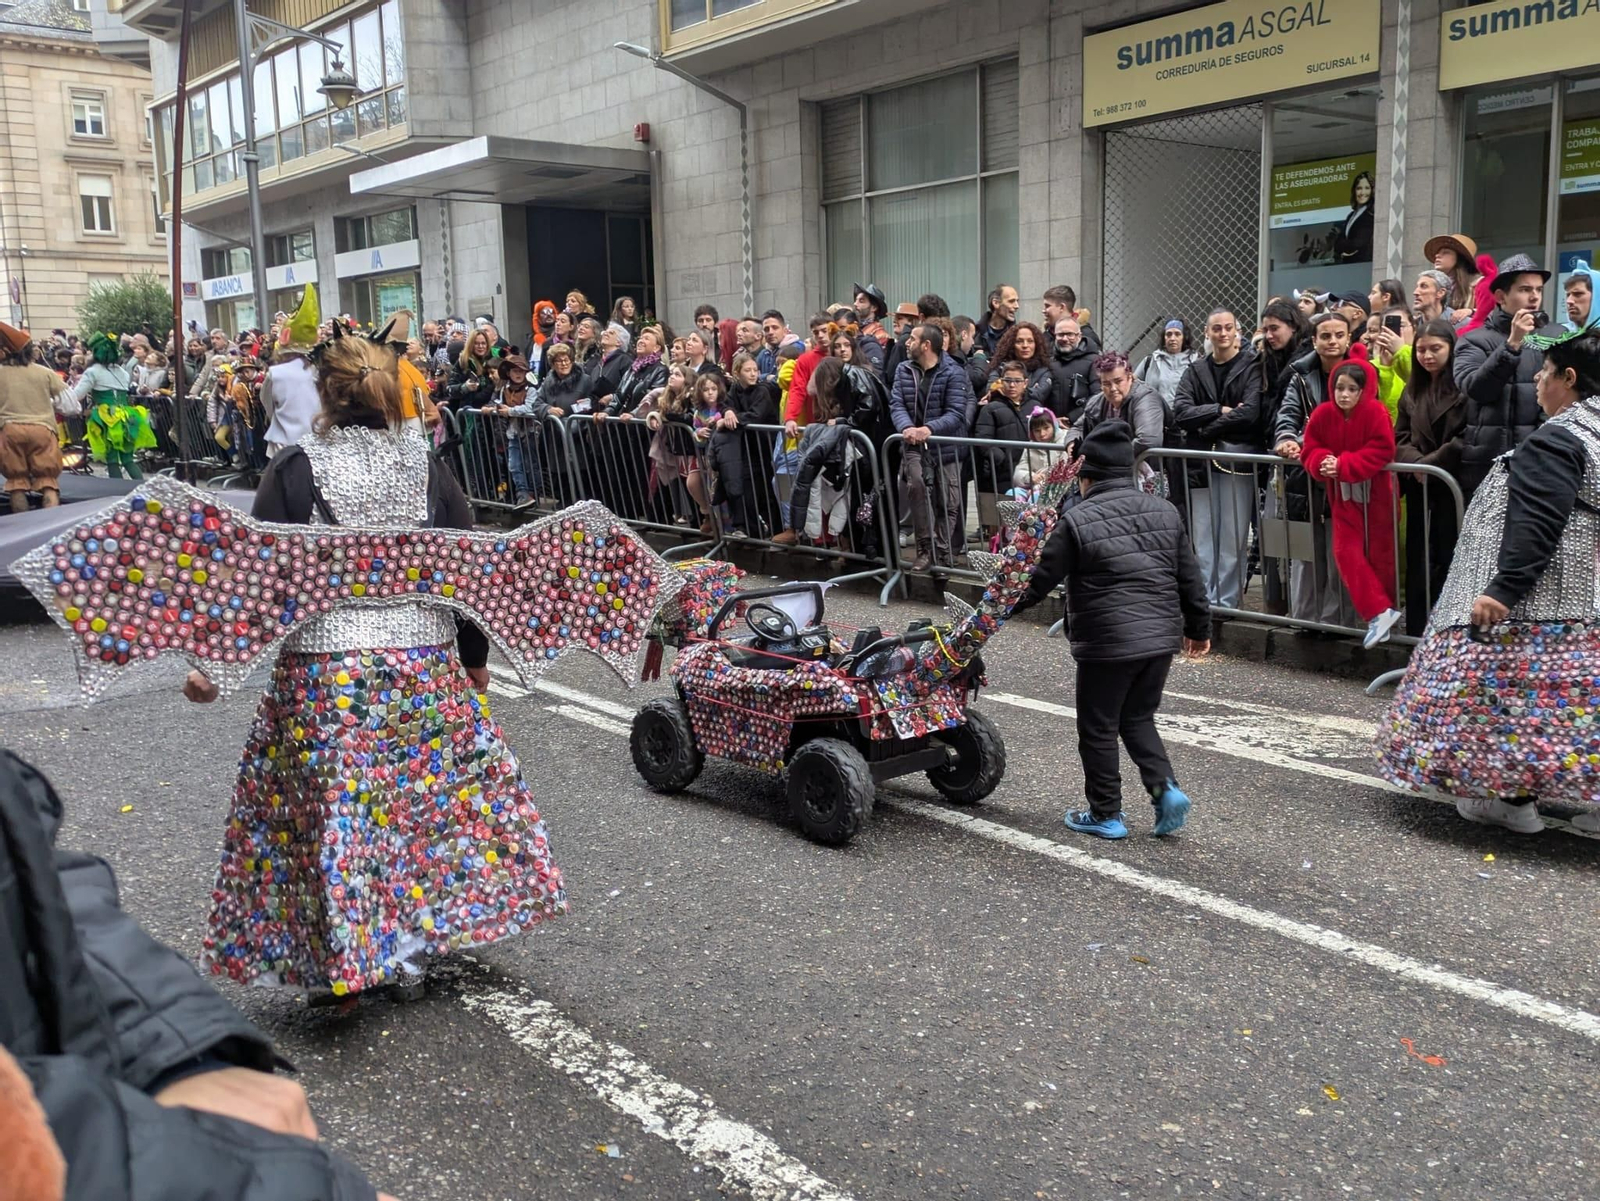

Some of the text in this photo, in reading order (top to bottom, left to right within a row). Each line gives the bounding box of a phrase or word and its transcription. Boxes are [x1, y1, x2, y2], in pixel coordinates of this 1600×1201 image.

[1155, 44, 1284, 81] CORREDURÍA DE SEGUROS
[1306, 53, 1371, 75] SUCURSAL 14
[1093, 107, 1105, 117] Tel:
[1119, 101, 1132, 111] 372
[1134, 99, 1146, 109] 100
[1275, 162, 1356, 181] TE DEFENDEMOS ANTE
[1565, 162, 1588, 172] ENTRA
[1589, 161, 1596, 169] Y
[1275, 173, 1349, 191] LAS ASEGURADORAS
